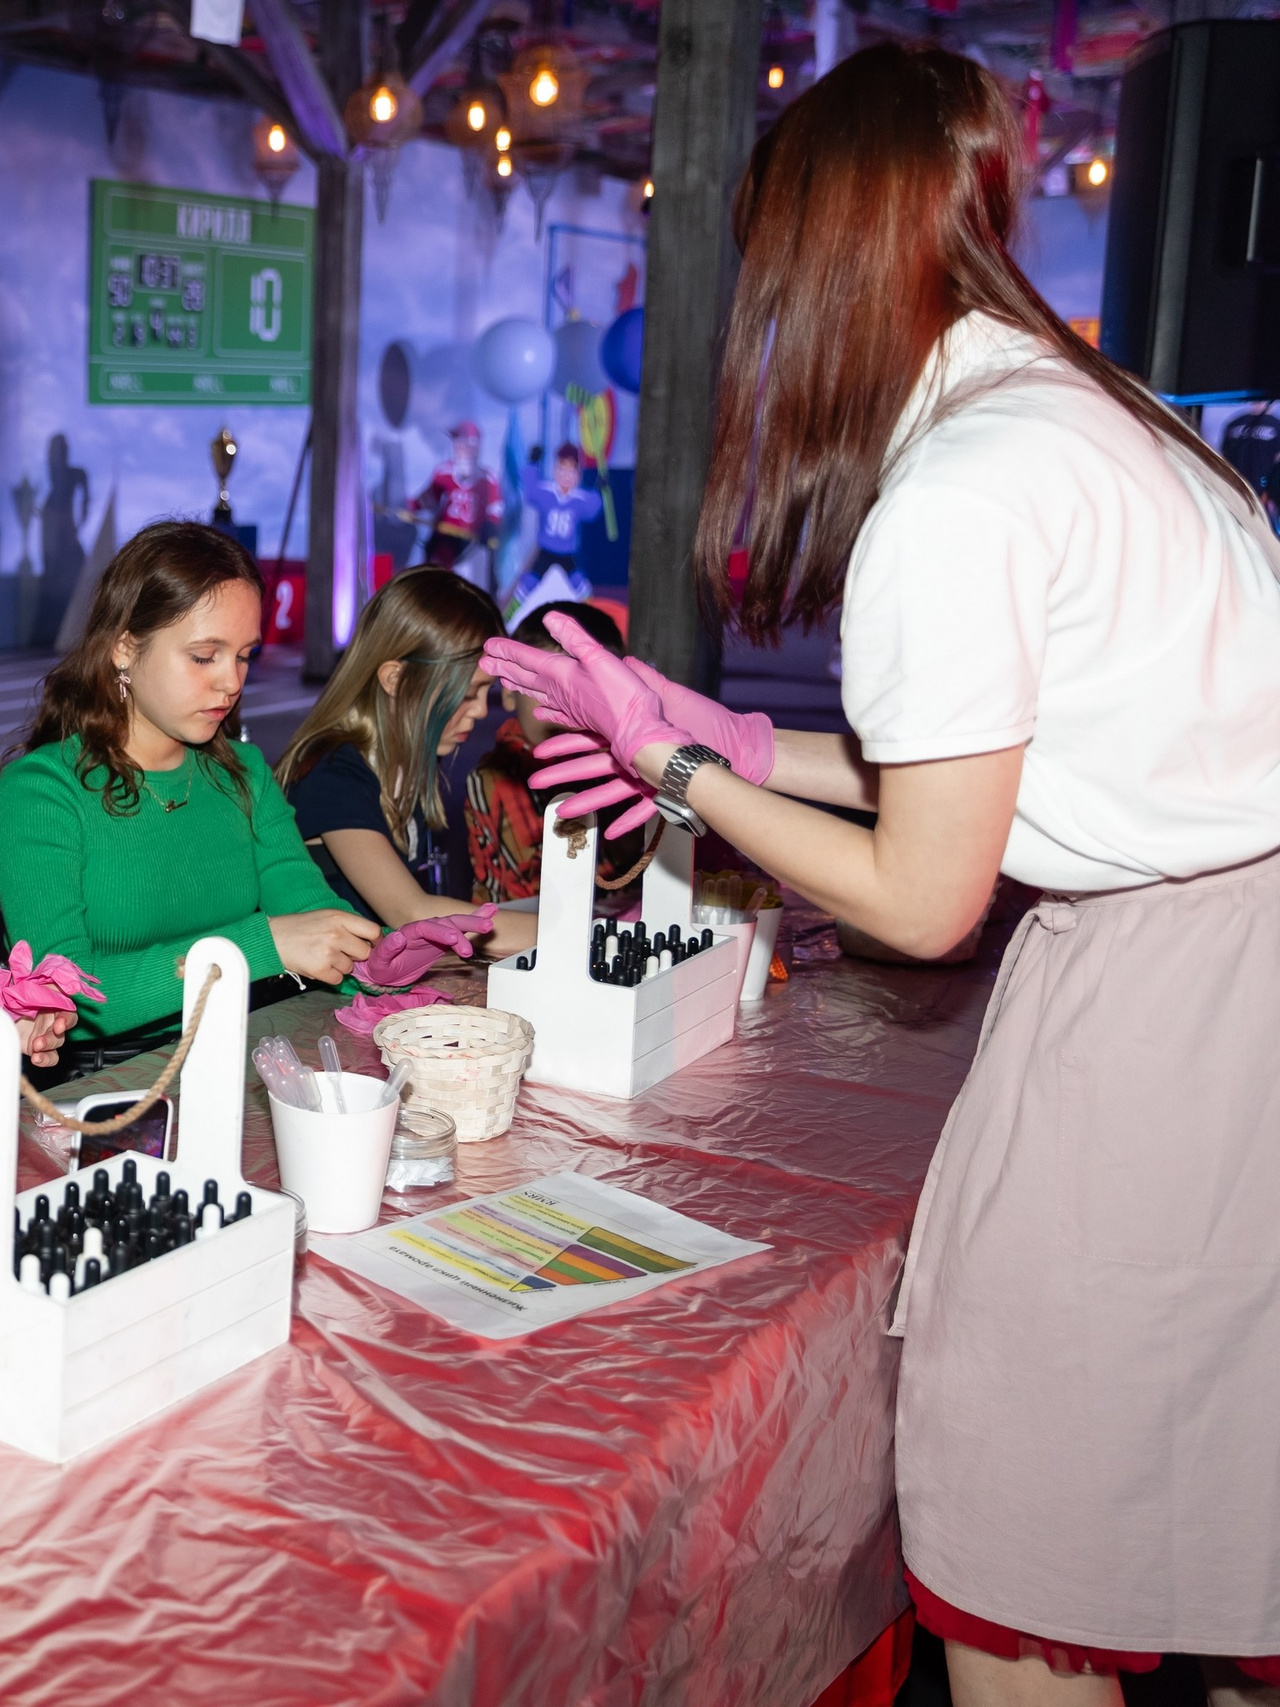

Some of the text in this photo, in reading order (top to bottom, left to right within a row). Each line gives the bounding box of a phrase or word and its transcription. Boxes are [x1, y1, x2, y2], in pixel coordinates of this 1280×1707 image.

[176, 203, 252, 244] КИРИЛЛ
[249, 267, 283, 342] 10
[275, 579, 294, 631] 2
[387, 1245, 435, 1268] аромата
[431, 1266, 462, 1281] цикл
[458, 1279, 528, 1312] Жизненный
